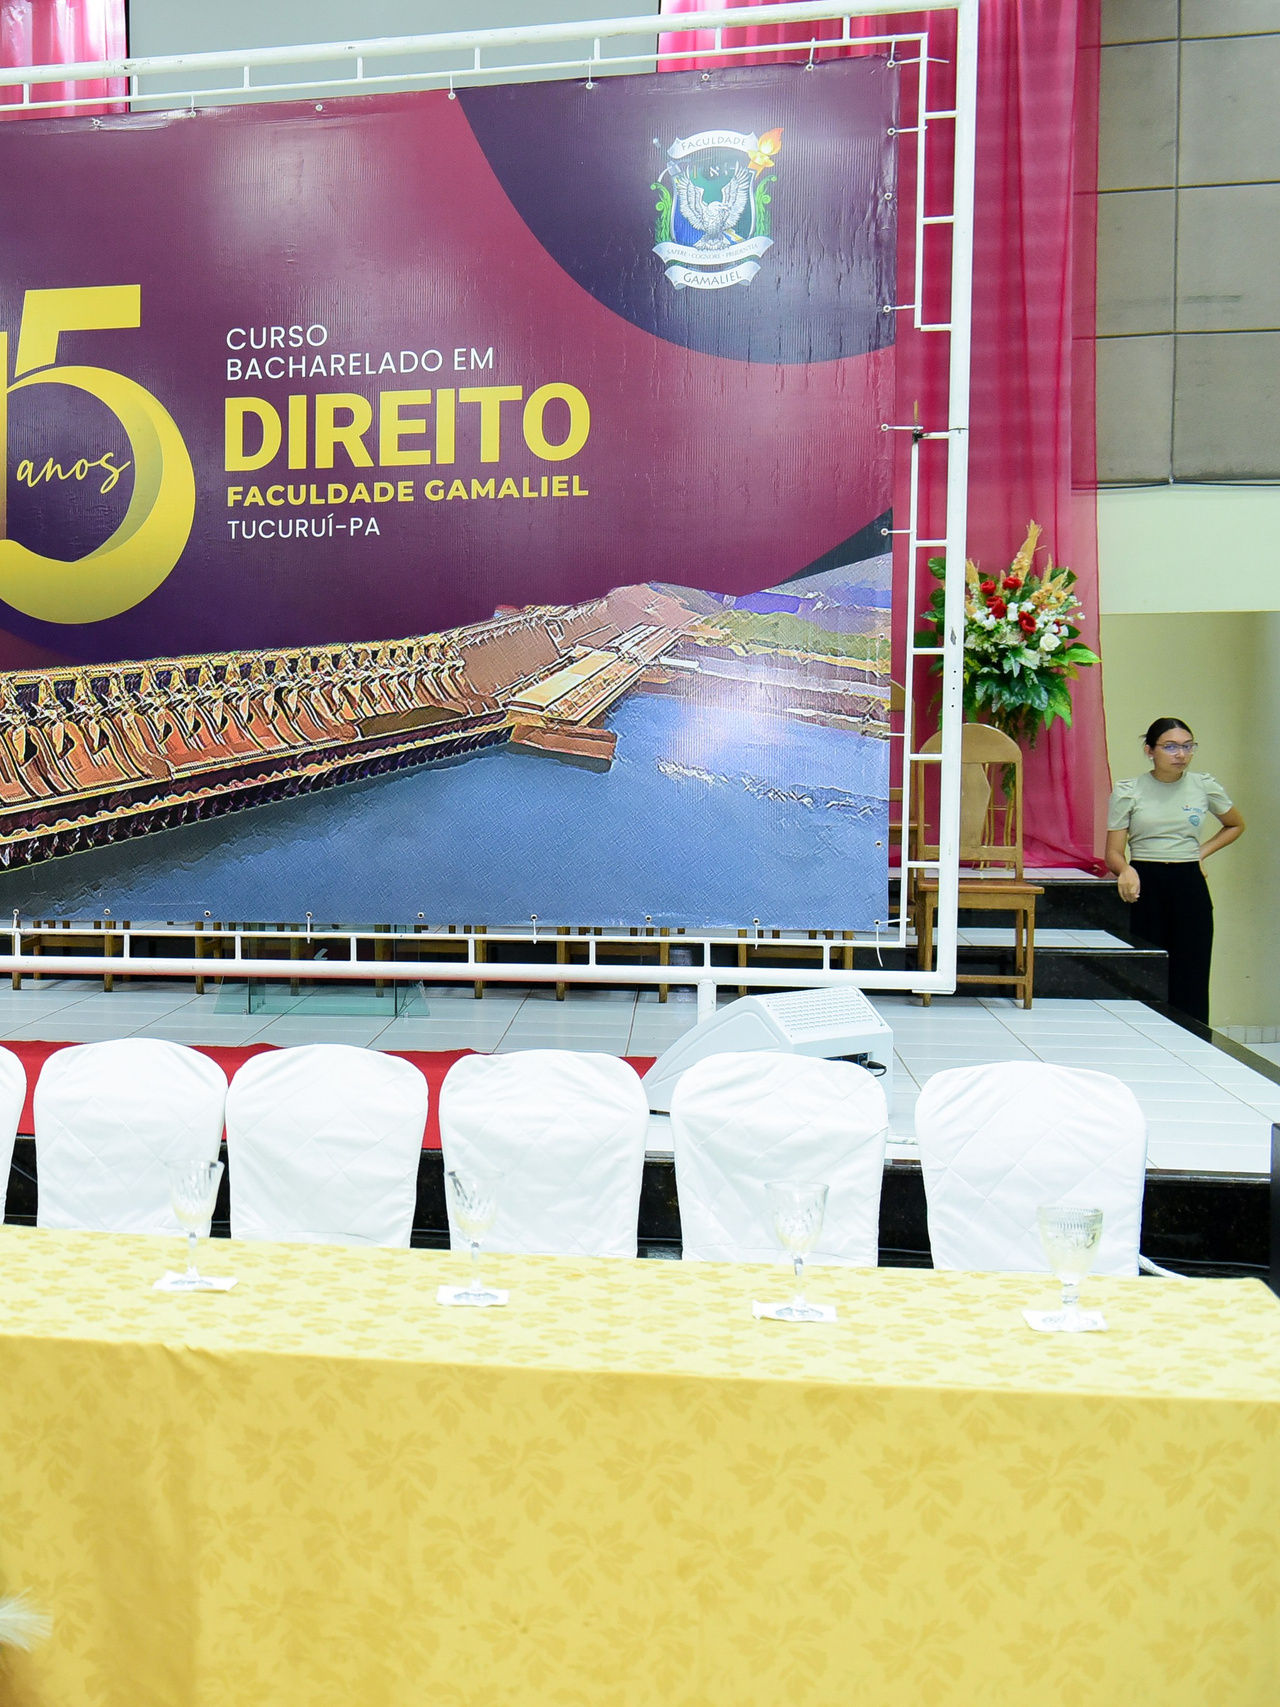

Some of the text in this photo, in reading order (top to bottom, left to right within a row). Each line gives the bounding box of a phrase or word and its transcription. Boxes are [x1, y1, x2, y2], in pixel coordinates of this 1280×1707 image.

[681, 136, 747, 151] FACULDADE
[683, 270, 742, 286] GAMALIEL
[225, 324, 328, 351] CURSO
[226, 346, 494, 381] BACHARELADO EM
[224, 382, 591, 471] DIREITO
[16, 452, 131, 494] anos
[227, 474, 589, 507] FACULDADE GAMALIEL
[227, 513, 381, 540] TUCURUÍ-PA
